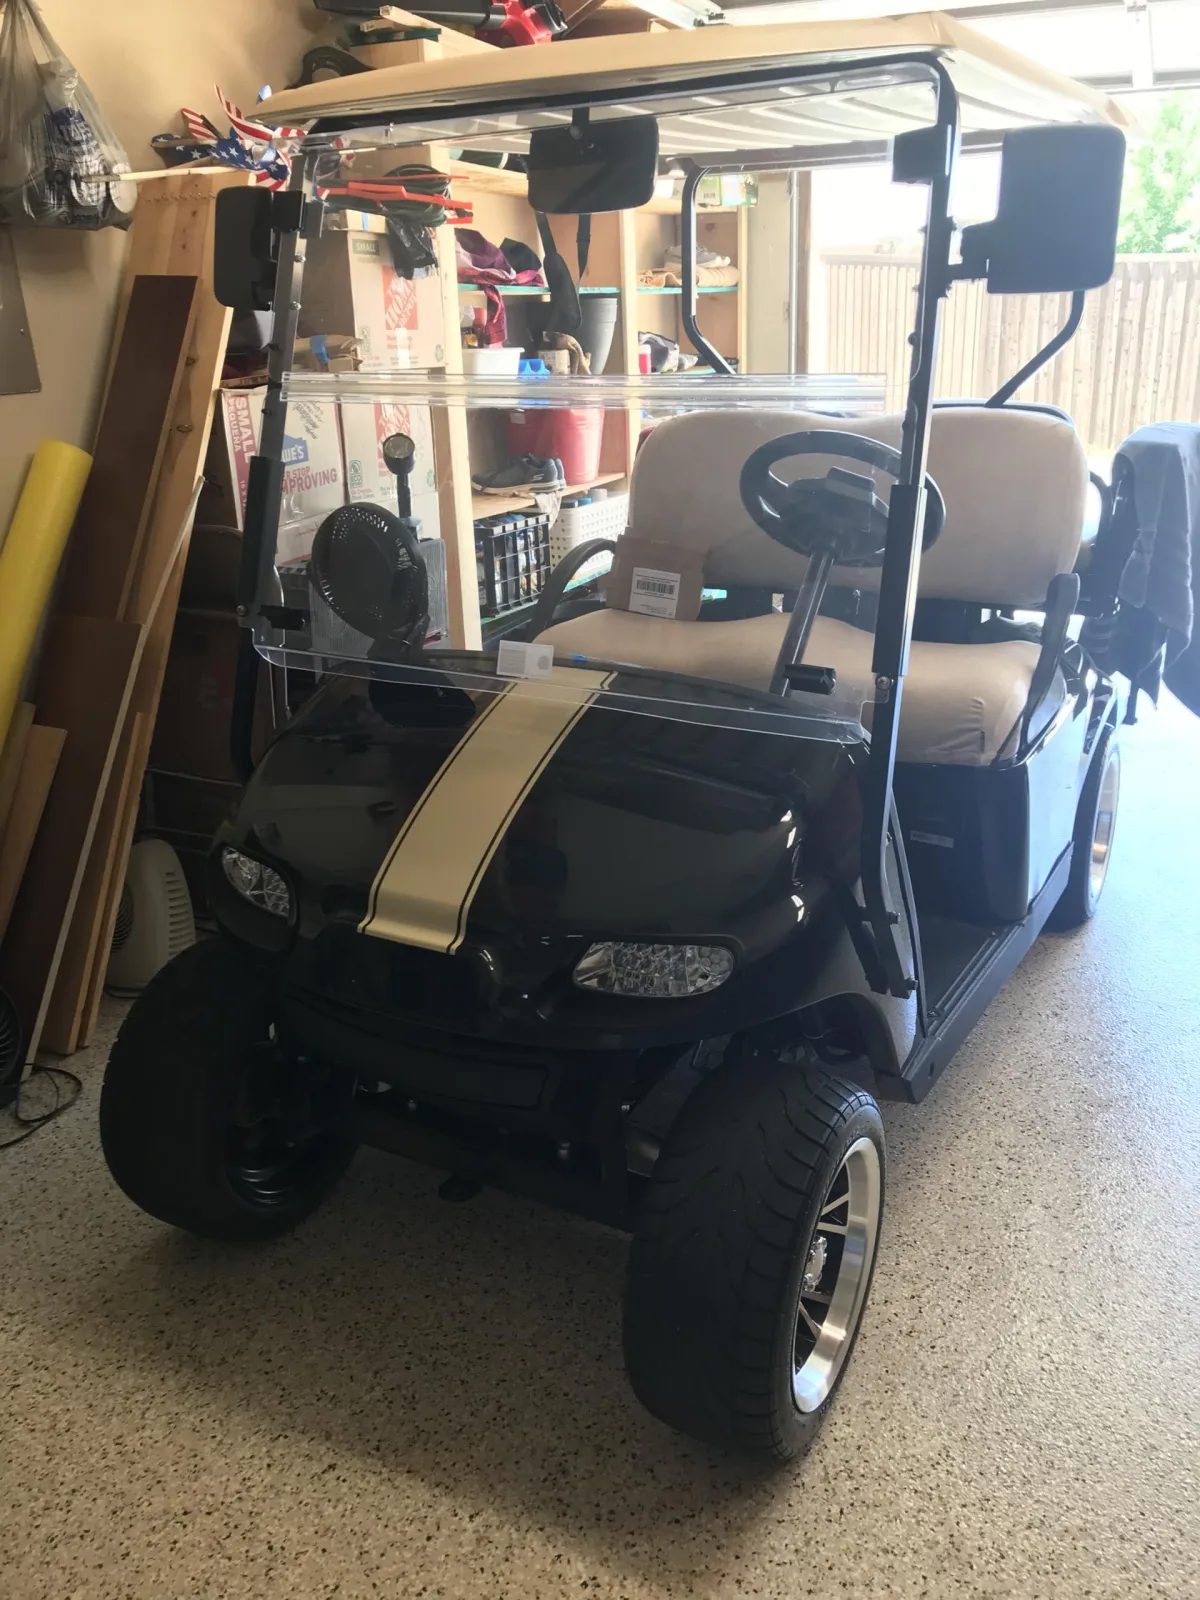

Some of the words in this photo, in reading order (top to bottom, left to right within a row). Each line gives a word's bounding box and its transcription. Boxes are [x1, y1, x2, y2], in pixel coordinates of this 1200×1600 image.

[355, 242, 376, 253] SMALL
[235, 397, 256, 464] SMALL
[281, 444, 304, 462] WE'S
[281, 467, 338, 494] MPROVING
[292, 466, 311, 478] STOP
